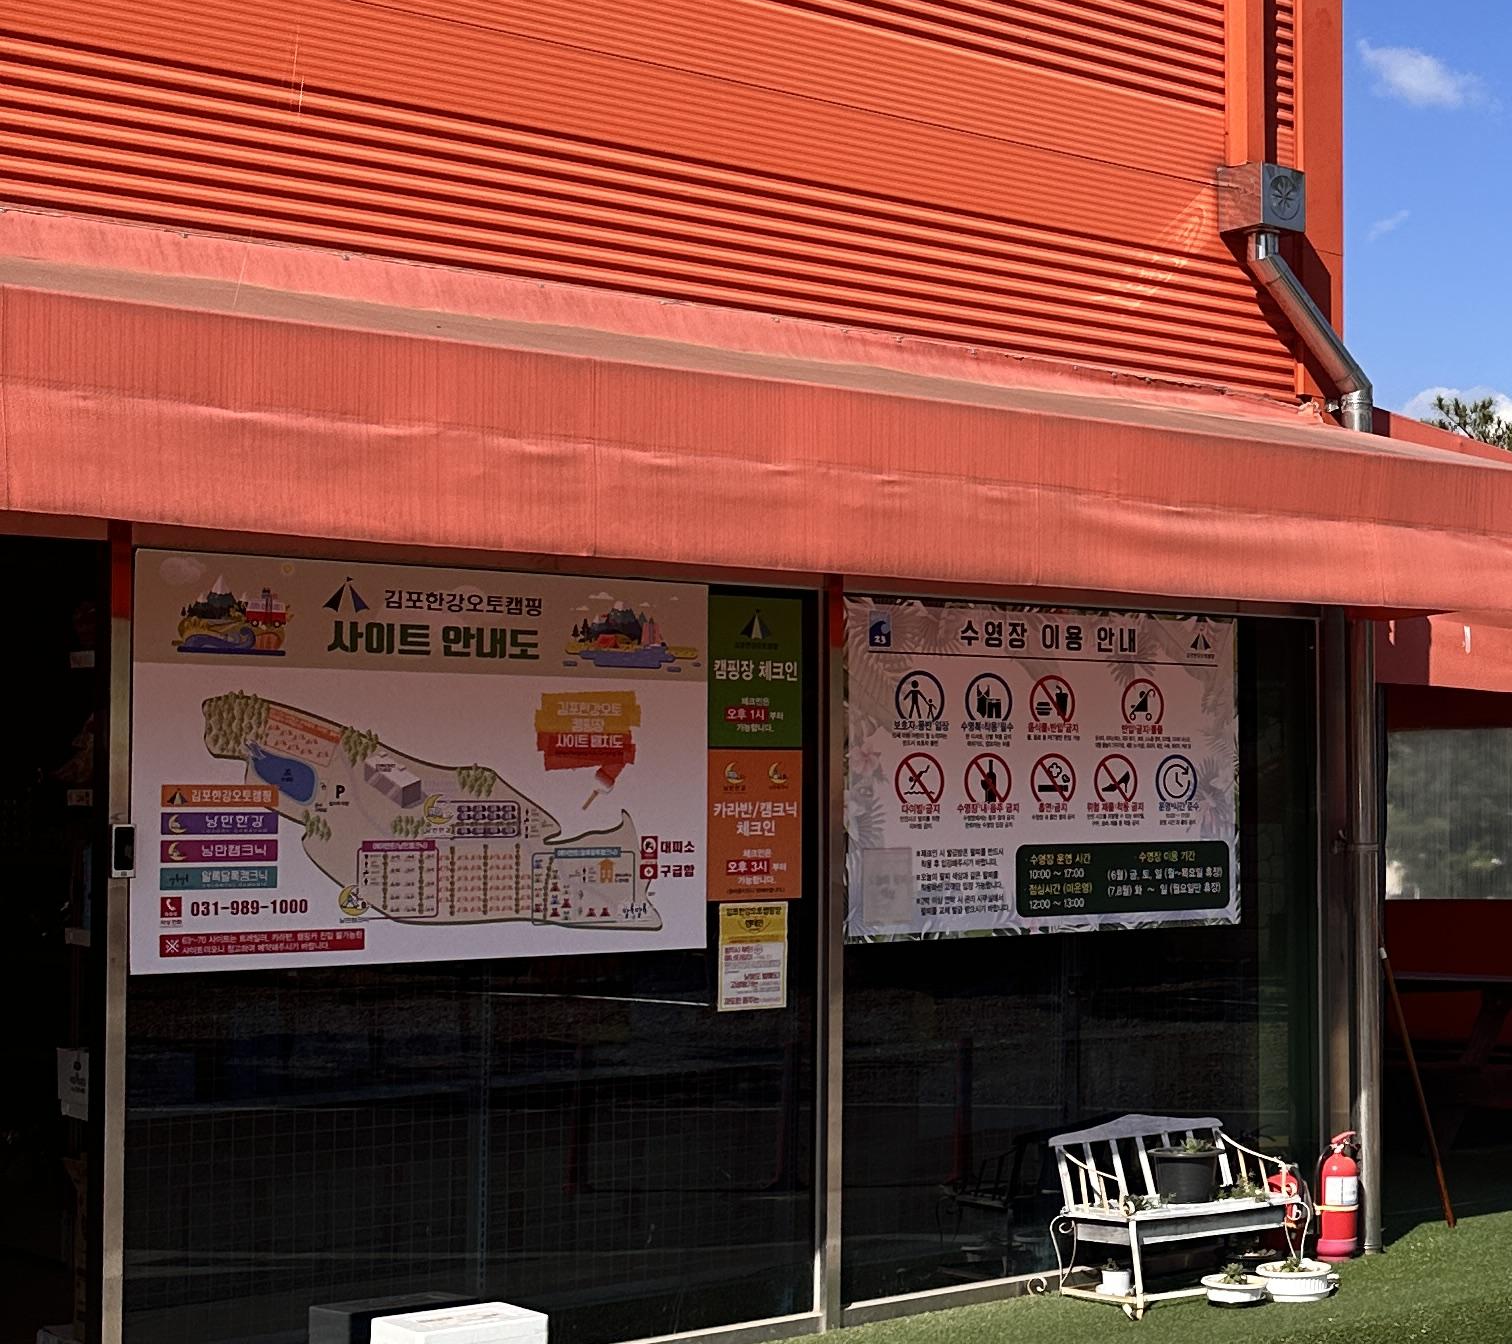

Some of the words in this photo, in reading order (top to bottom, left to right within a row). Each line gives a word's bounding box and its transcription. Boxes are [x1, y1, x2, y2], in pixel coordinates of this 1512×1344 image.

[384, 589, 543, 617] 김포한강오토캠핑
[327, 620, 431, 655] 사이트
[442, 625, 540, 660] 안내도
[960, 620, 1027, 650] 수영장
[1041, 624, 1083, 652] 이용
[1096, 626, 1138, 654] 안내
[713, 659, 754, 681] 캠핑장
[758, 660, 798, 682] 체크인
[726, 708, 748, 721] 오후
[750, 709, 766, 721] 1시
[555, 734, 590, 748] 사이트
[191, 789, 273, 803] 김포한강오토캠핑
[713, 801, 798, 818] 카라반/캠크닉
[205, 815, 265, 828] 낭만한강
[736, 820, 776, 837] 체크인
[660, 841, 696, 854] 대피소
[1029, 853, 1055, 866] 수영장
[1056, 853, 1073, 865] 운영
[1074, 852, 1091, 865] 시간
[1138, 850, 1162, 863] 수영장
[1180, 850, 1196, 862] 기간
[660, 864, 695, 878] 구급함
[727, 861, 748, 873] 오후
[751, 861, 768, 873] 3시
[1028, 869, 1051, 879] 10:00
[1028, 883, 1061, 896] 점심시간
[1062, 882, 1093, 896] (미운영)
[190, 899, 308, 917] 031-989-1000
[1028, 898, 1051, 909] 12:00
